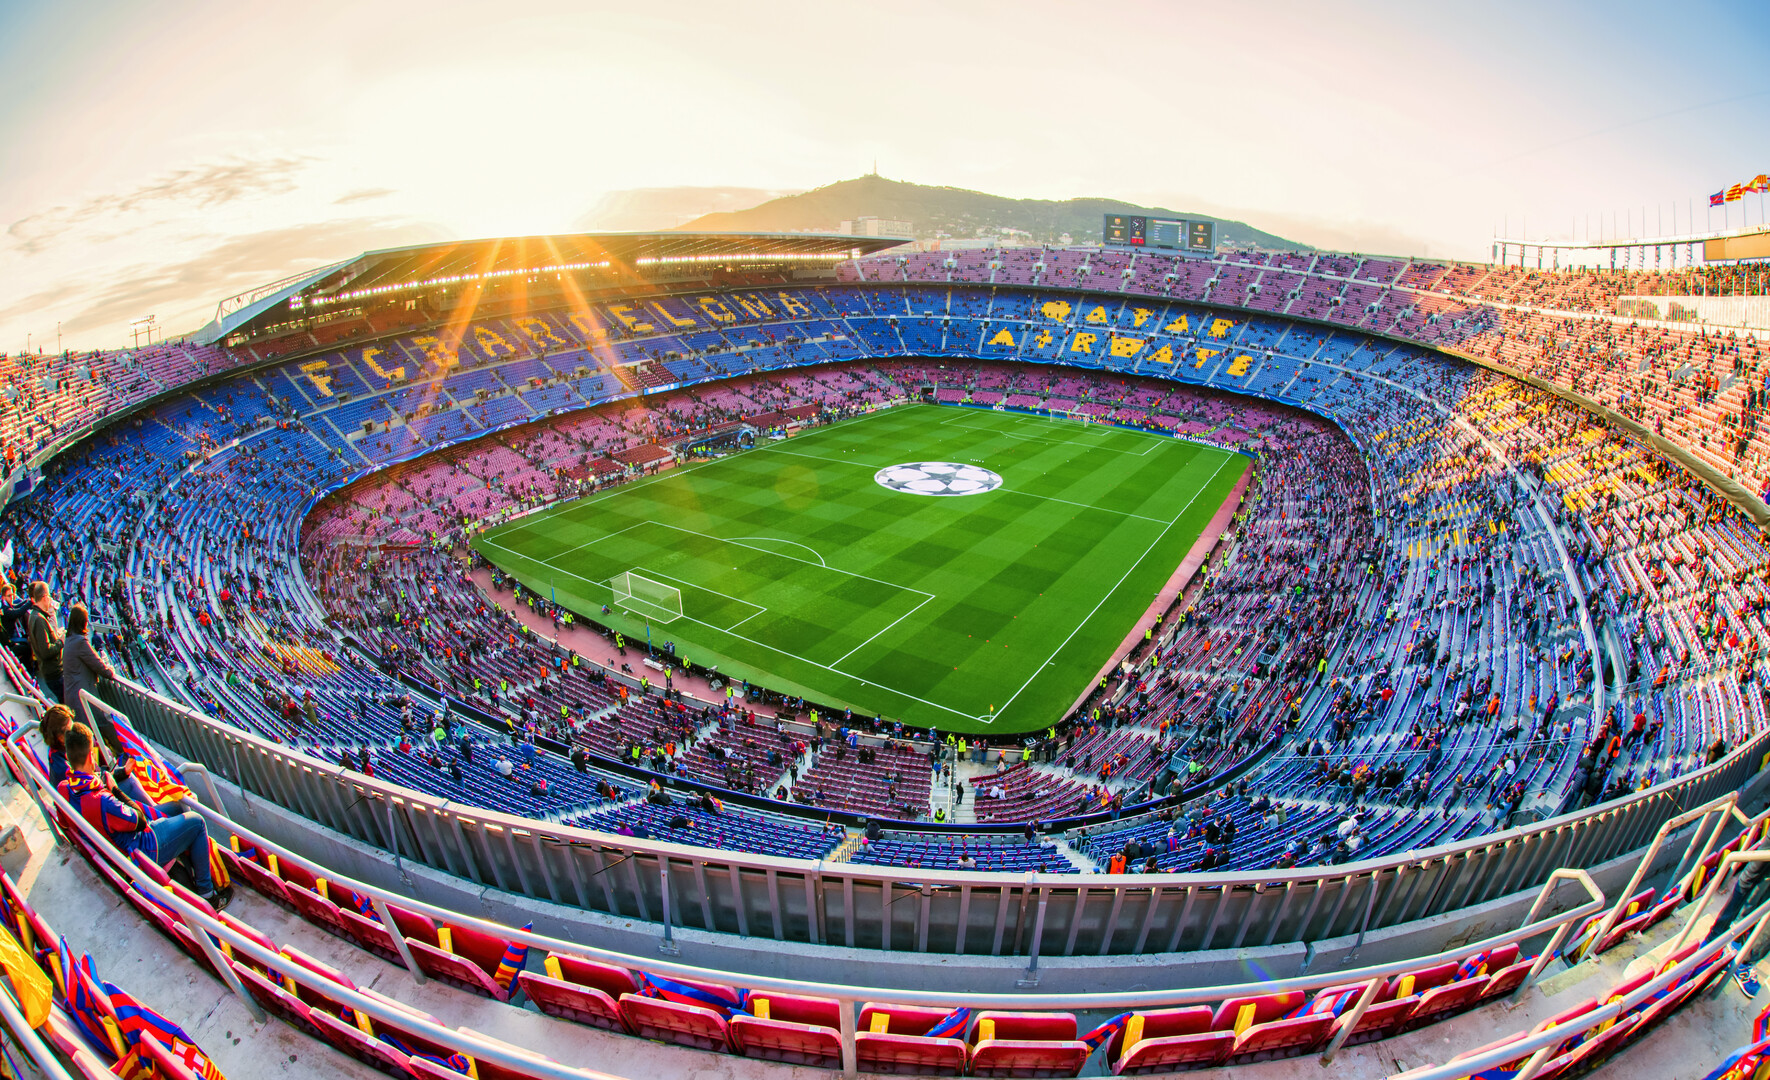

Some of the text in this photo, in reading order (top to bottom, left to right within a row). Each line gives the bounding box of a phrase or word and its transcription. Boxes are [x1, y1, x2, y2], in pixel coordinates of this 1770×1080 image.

[298, 292, 812, 396] FC BARCELONA
[1188, 435, 1219, 447] CHAMPIONS
[1220, 443, 1240, 453] LEAGUE
